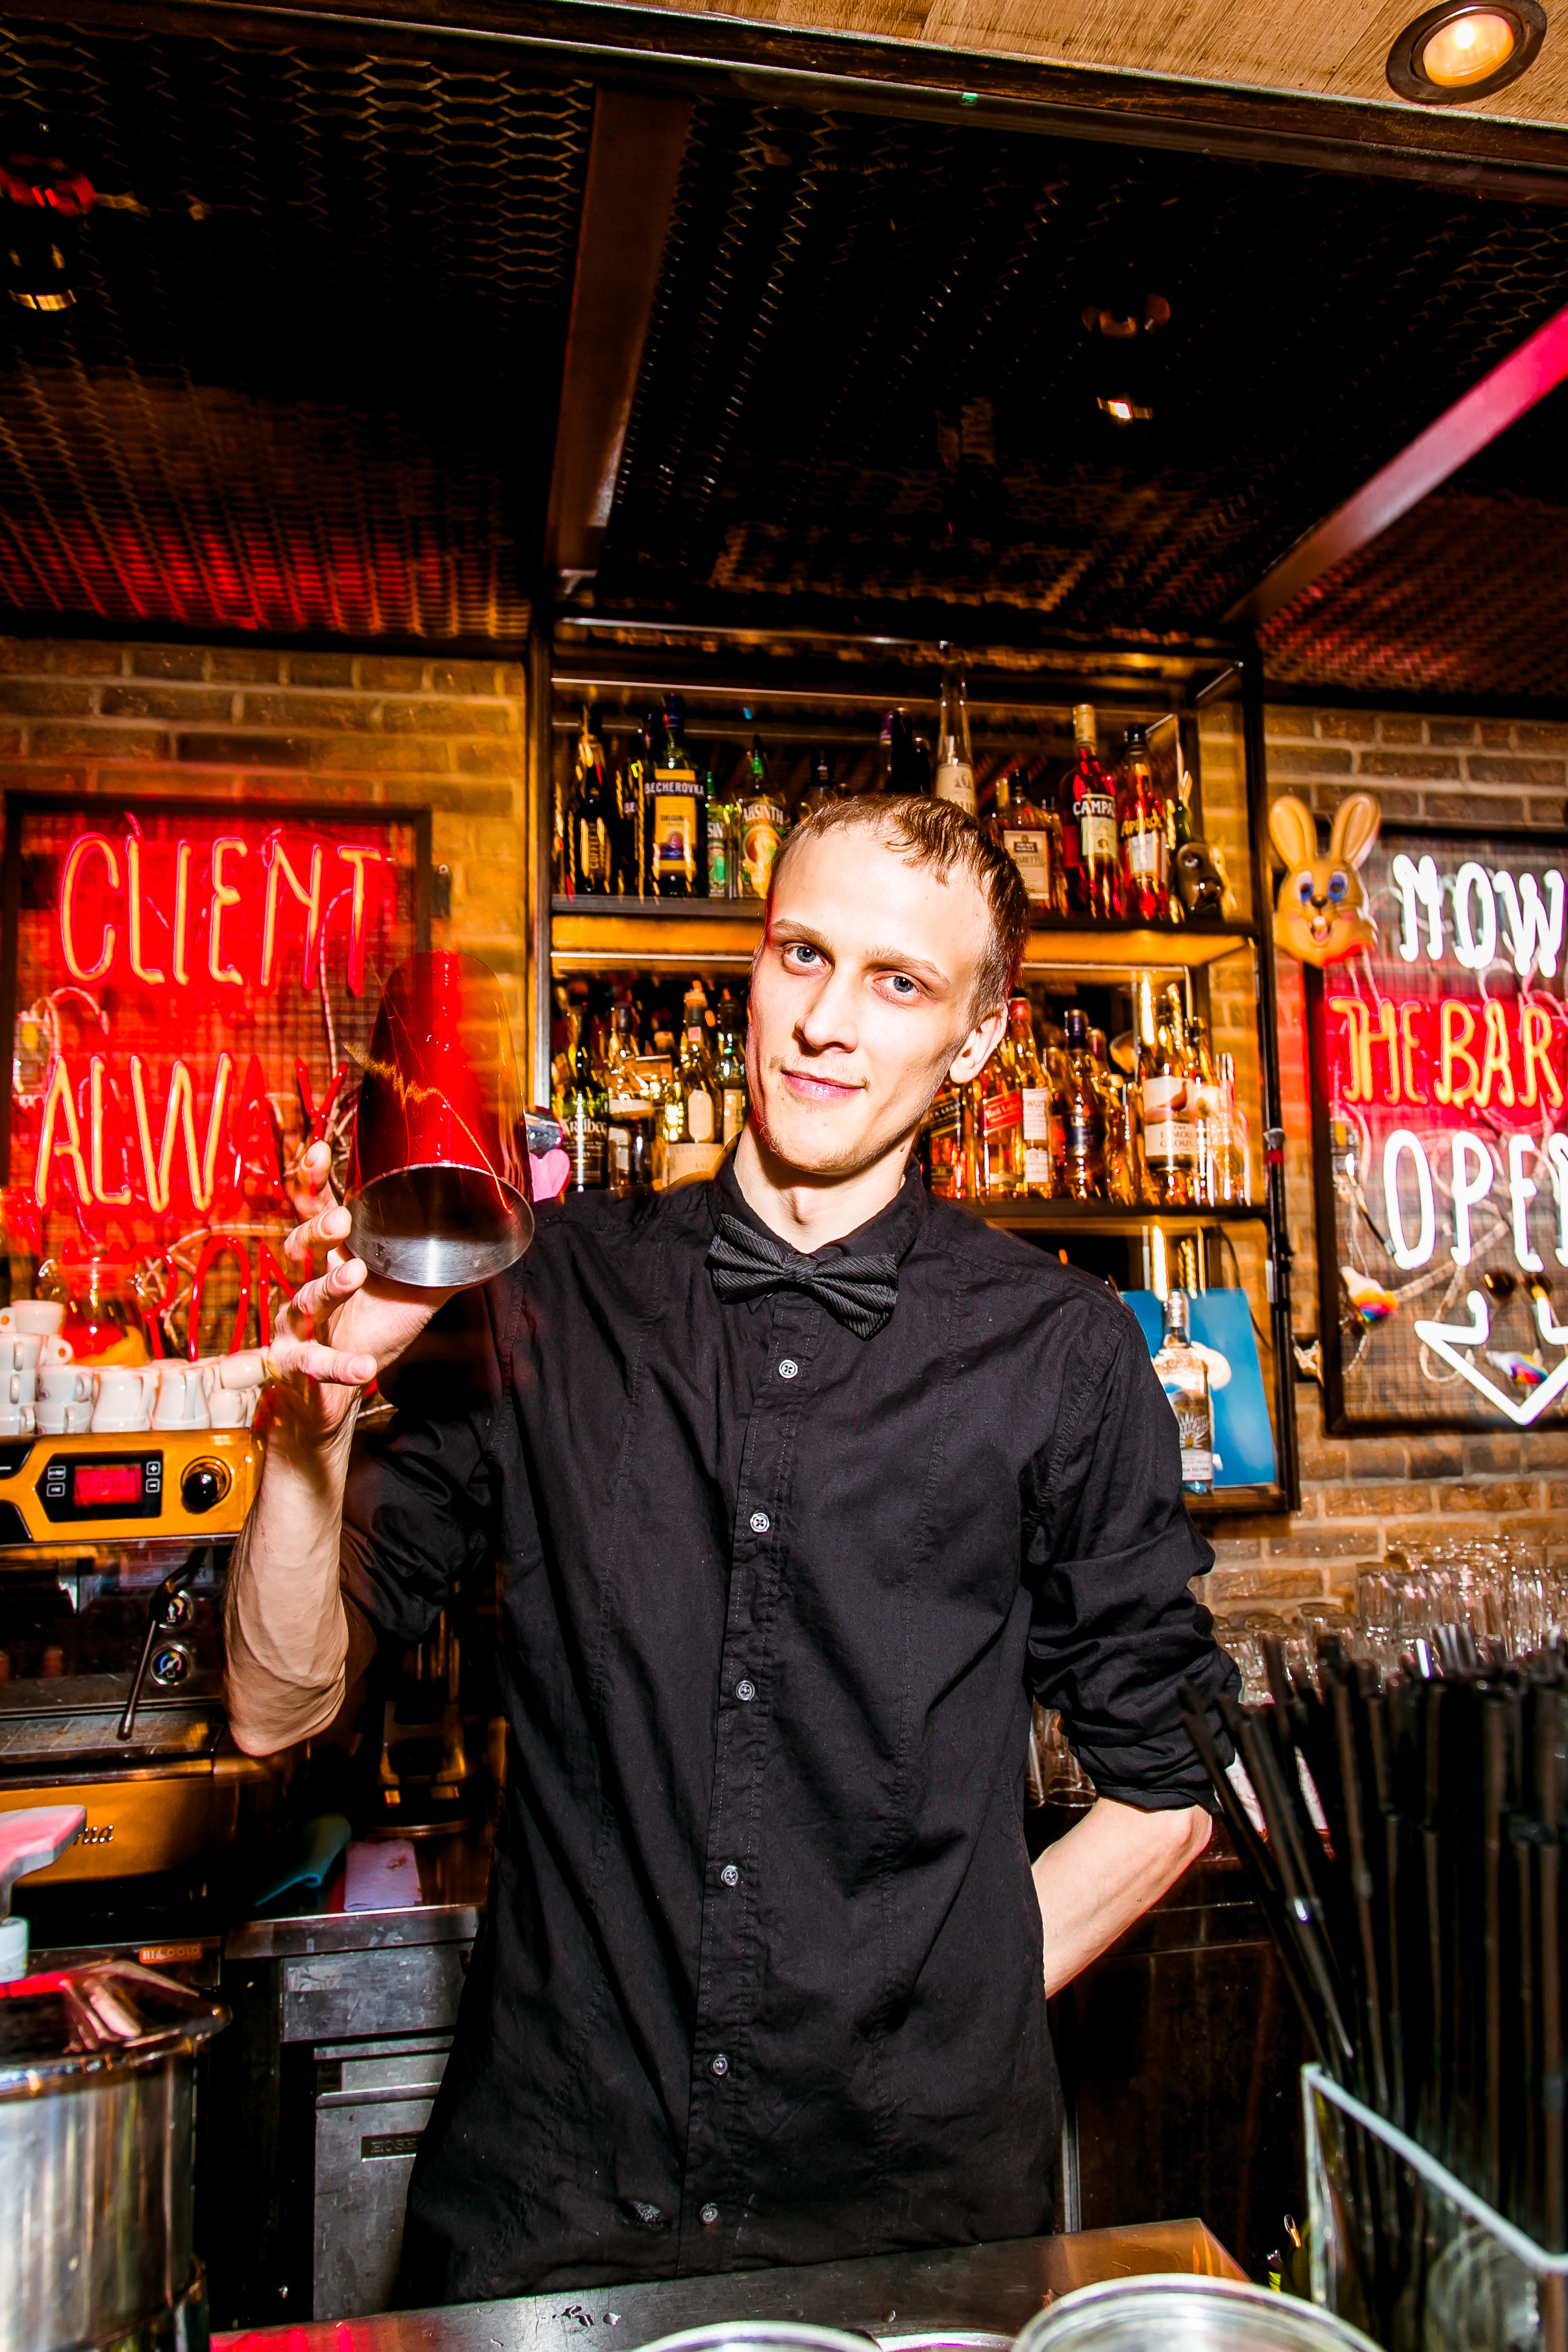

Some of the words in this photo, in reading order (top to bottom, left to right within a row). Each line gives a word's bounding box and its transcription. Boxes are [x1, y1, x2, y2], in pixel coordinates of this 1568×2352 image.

[61, 831, 383, 997] CLIENT
[1393, 854, 1567, 978] NOW
[1329, 995, 1428, 1105] THE
[1434, 997, 1563, 1109] BAR
